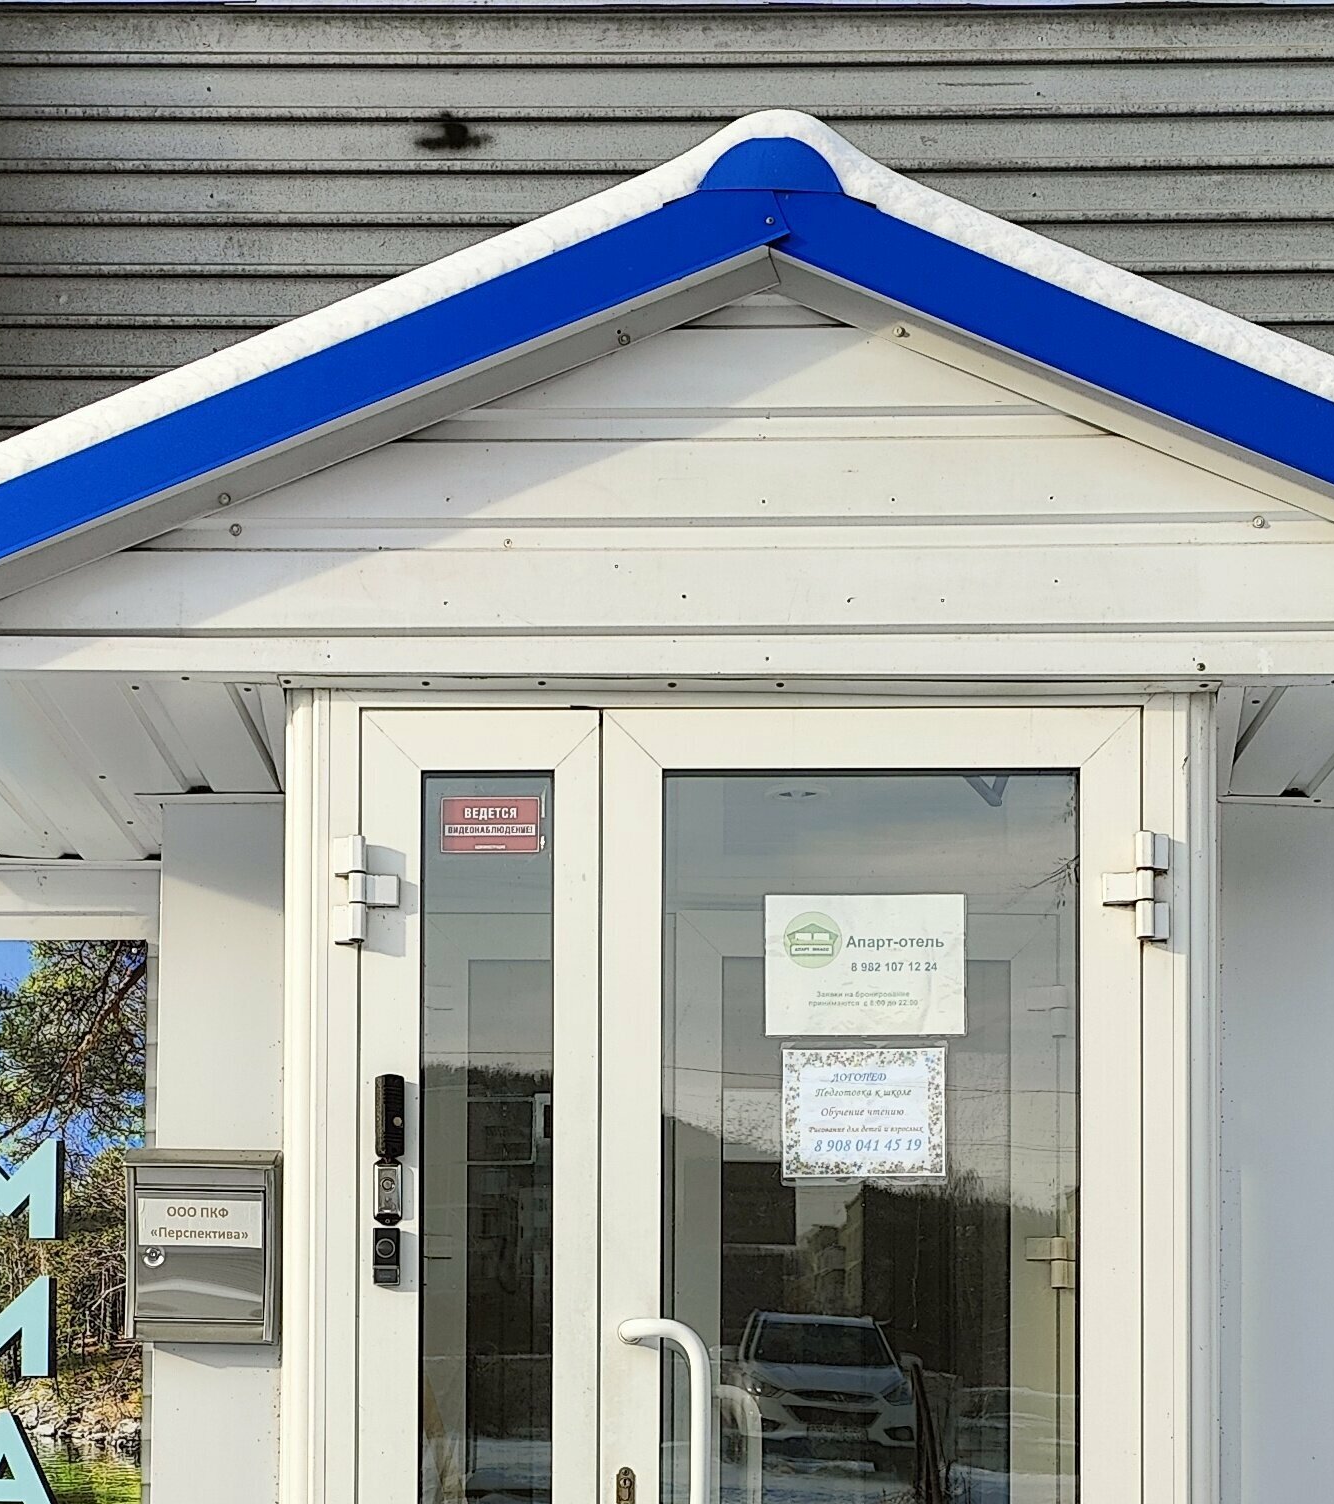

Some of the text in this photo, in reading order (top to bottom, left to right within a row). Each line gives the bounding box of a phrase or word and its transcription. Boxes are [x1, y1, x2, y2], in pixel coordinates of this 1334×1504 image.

[464, 808, 517, 820] ВЕДЕТСЯ
[846, 935, 944, 950] Апарт-отель
[851, 962, 937, 972] 8 982 107 12 24
[831, 1072, 887, 1082] ЛОГОПЕД
[815, 1088, 872, 1098] Подготовка
[883, 1089, 912, 1098] школе
[821, 1107, 864, 1119] Обучение
[815, 1138, 922, 1152] 8 908 041 45 19
[167, 1207, 229, 1218] ООО ПКФ
[151, 1227, 248, 1240] «Перспектива»
